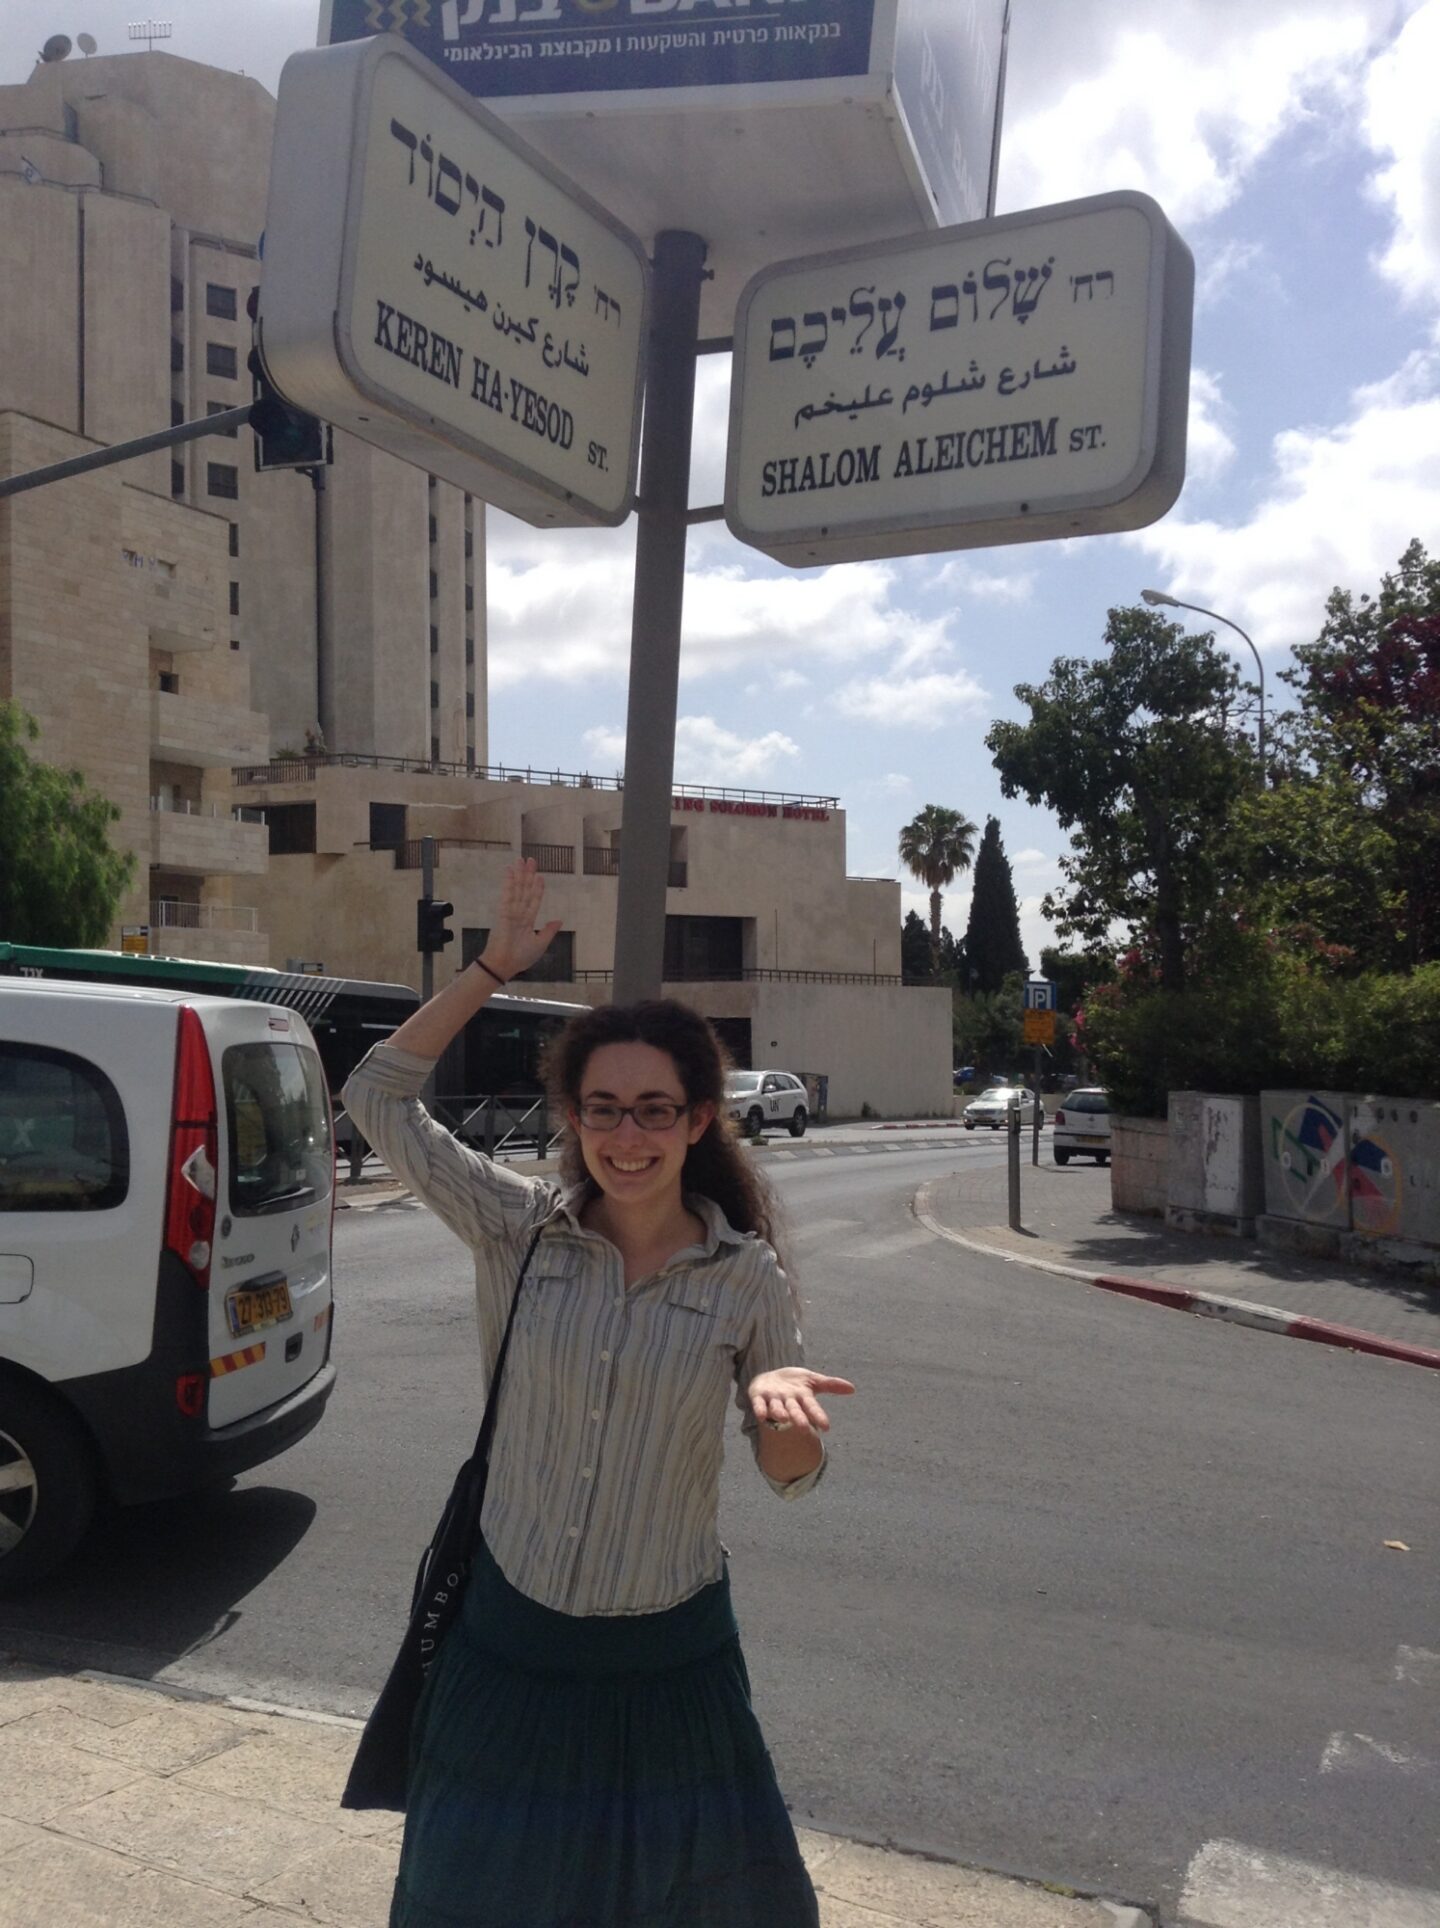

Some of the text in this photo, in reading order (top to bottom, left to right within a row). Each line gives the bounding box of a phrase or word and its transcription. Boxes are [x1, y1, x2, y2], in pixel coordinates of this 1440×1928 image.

[443, 22, 841, 62] בנקאות פרטית והשקעות מקבוצת הבינלאומי
[413, 253, 590, 377] شارع كيرن هيسود
[374, 300, 464, 389] KEREN
[587, 441, 609, 473] ST.
[794, 345, 1078, 429] شارع شلوم عليخم
[761, 417, 1106, 497] SHALOM ALEICHEM ST.
[672, 797, 704, 813] ING
